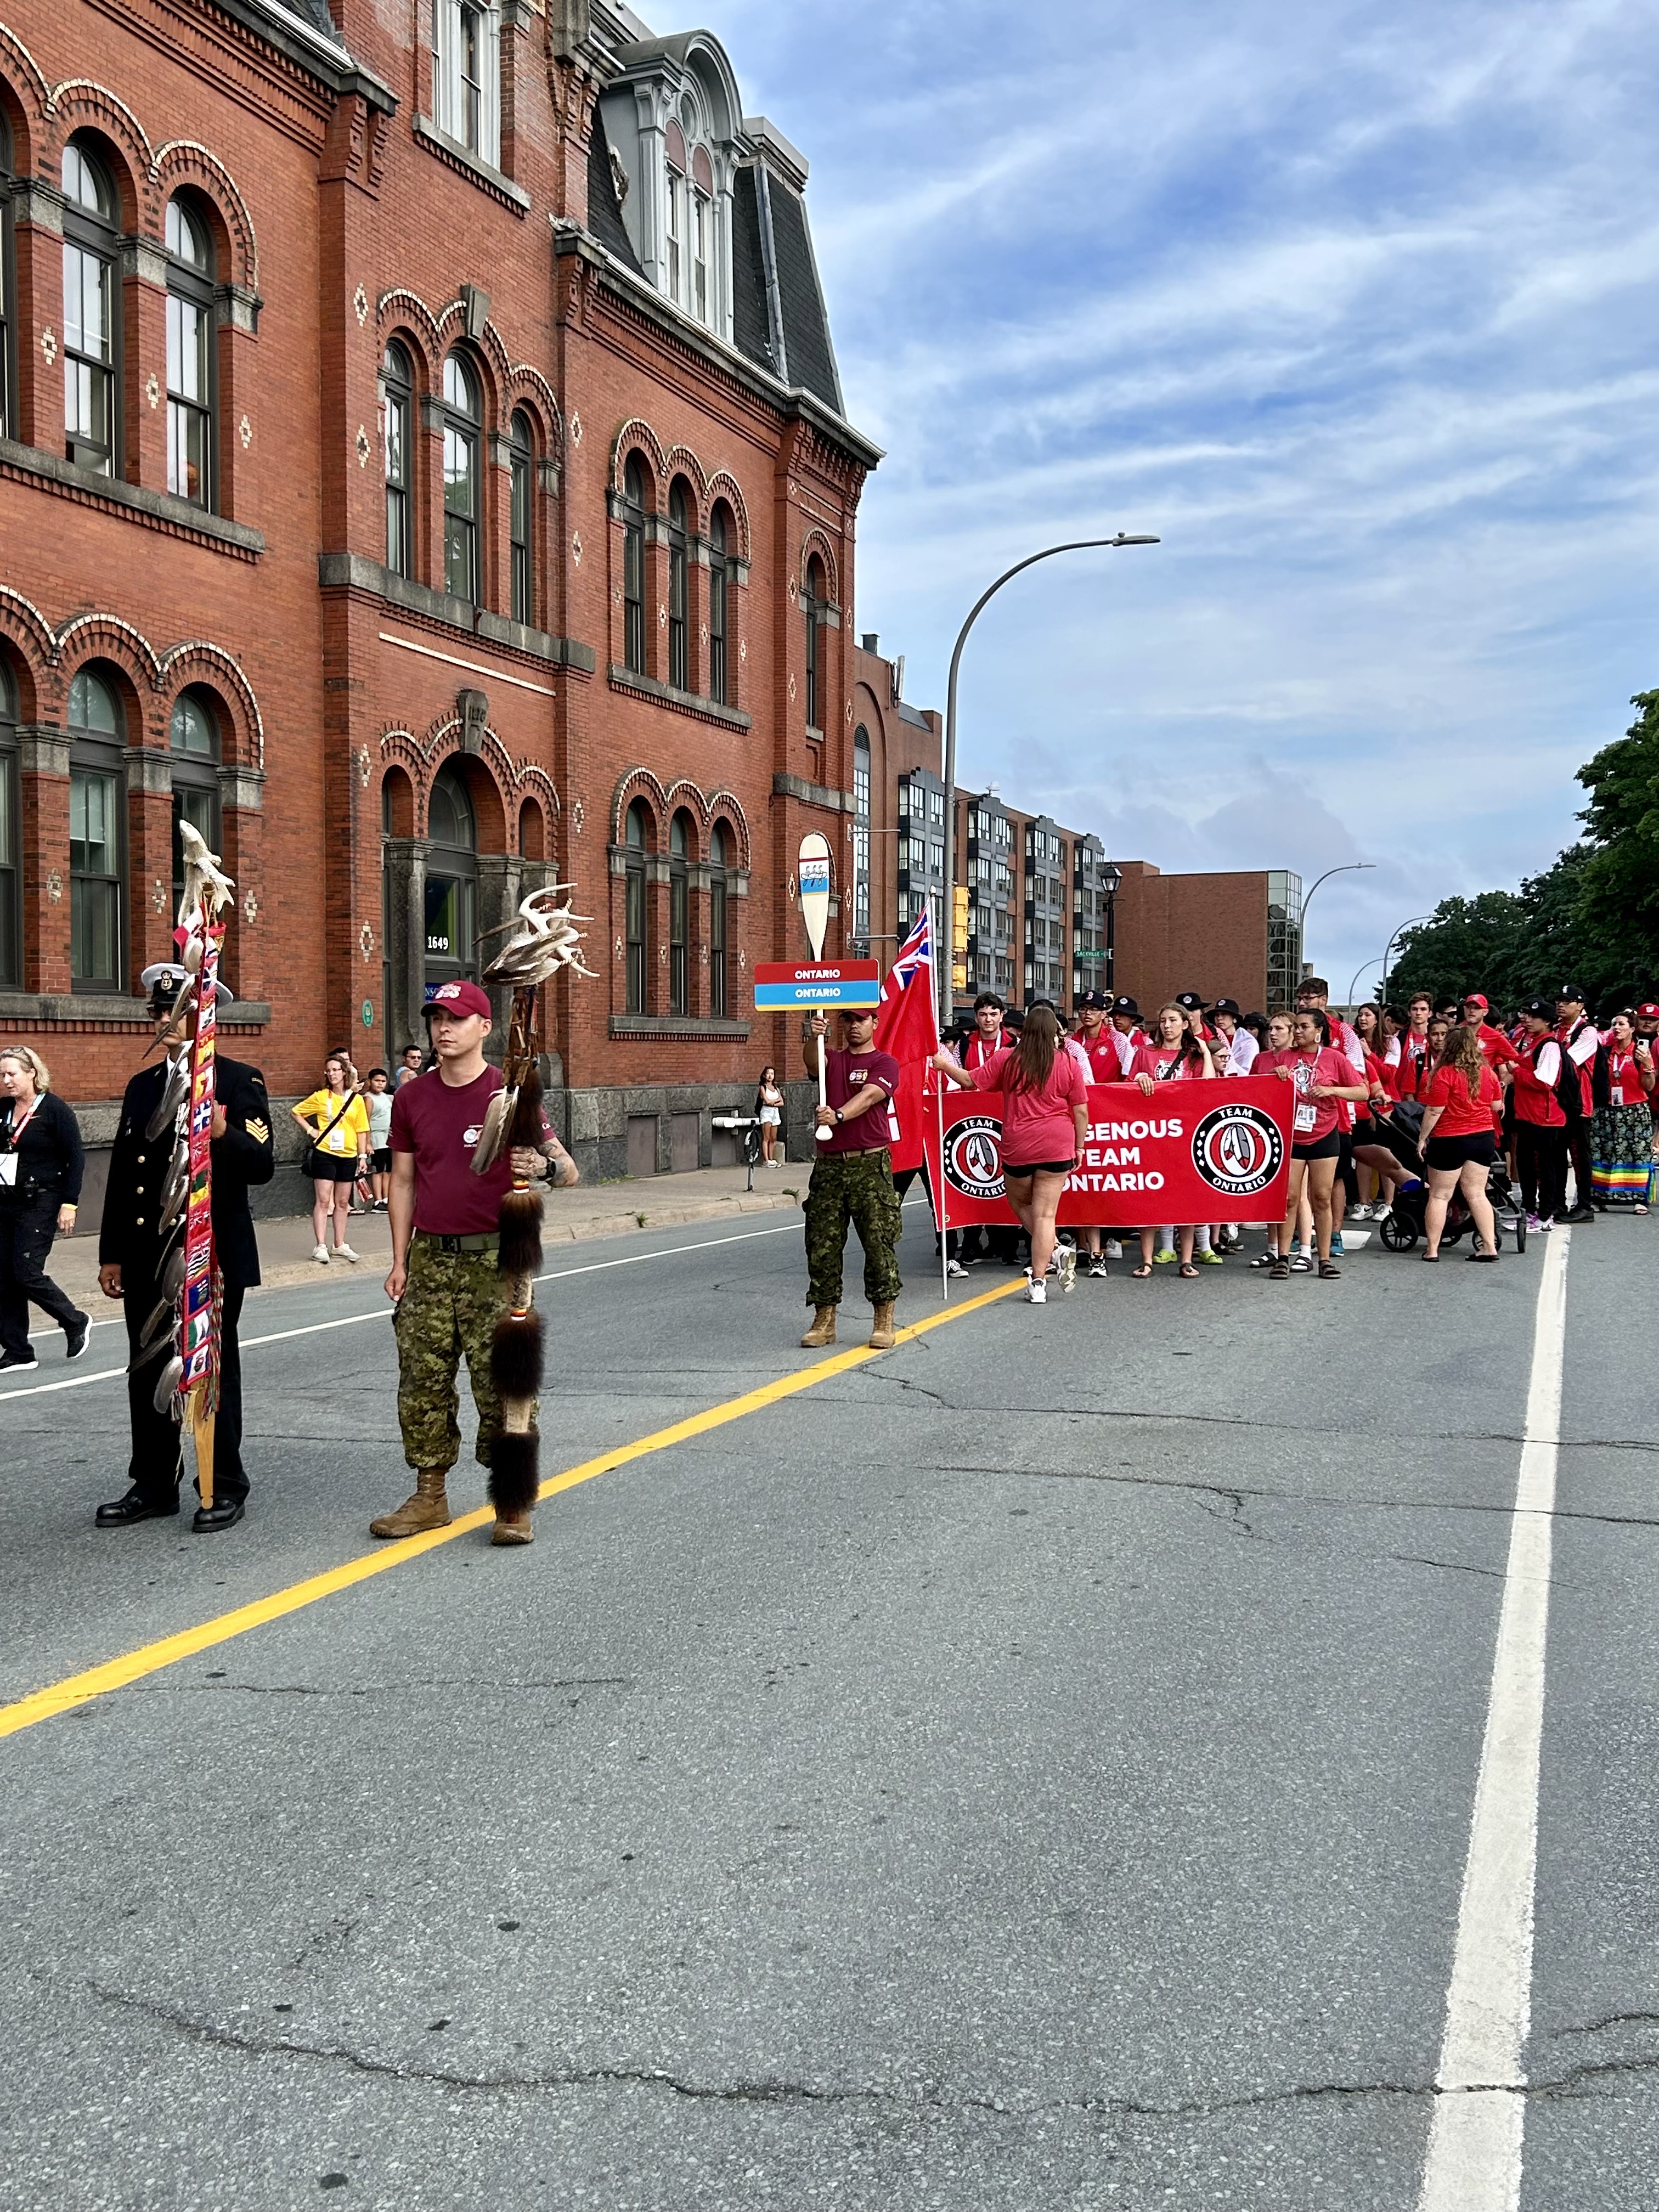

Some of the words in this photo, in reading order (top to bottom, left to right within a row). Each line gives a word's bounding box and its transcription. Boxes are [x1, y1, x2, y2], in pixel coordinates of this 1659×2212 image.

[428, 936, 449, 950] 1649
[795, 969, 840, 979] ONTARIO
[795, 988, 840, 998] ONTARIO
[1218, 1108, 1252, 1118] TEAM
[962, 1119, 993, 1129] TEAM
[1085, 1147, 1141, 1167] EAM
[1212, 1176, 1266, 1192] ONTARIO
